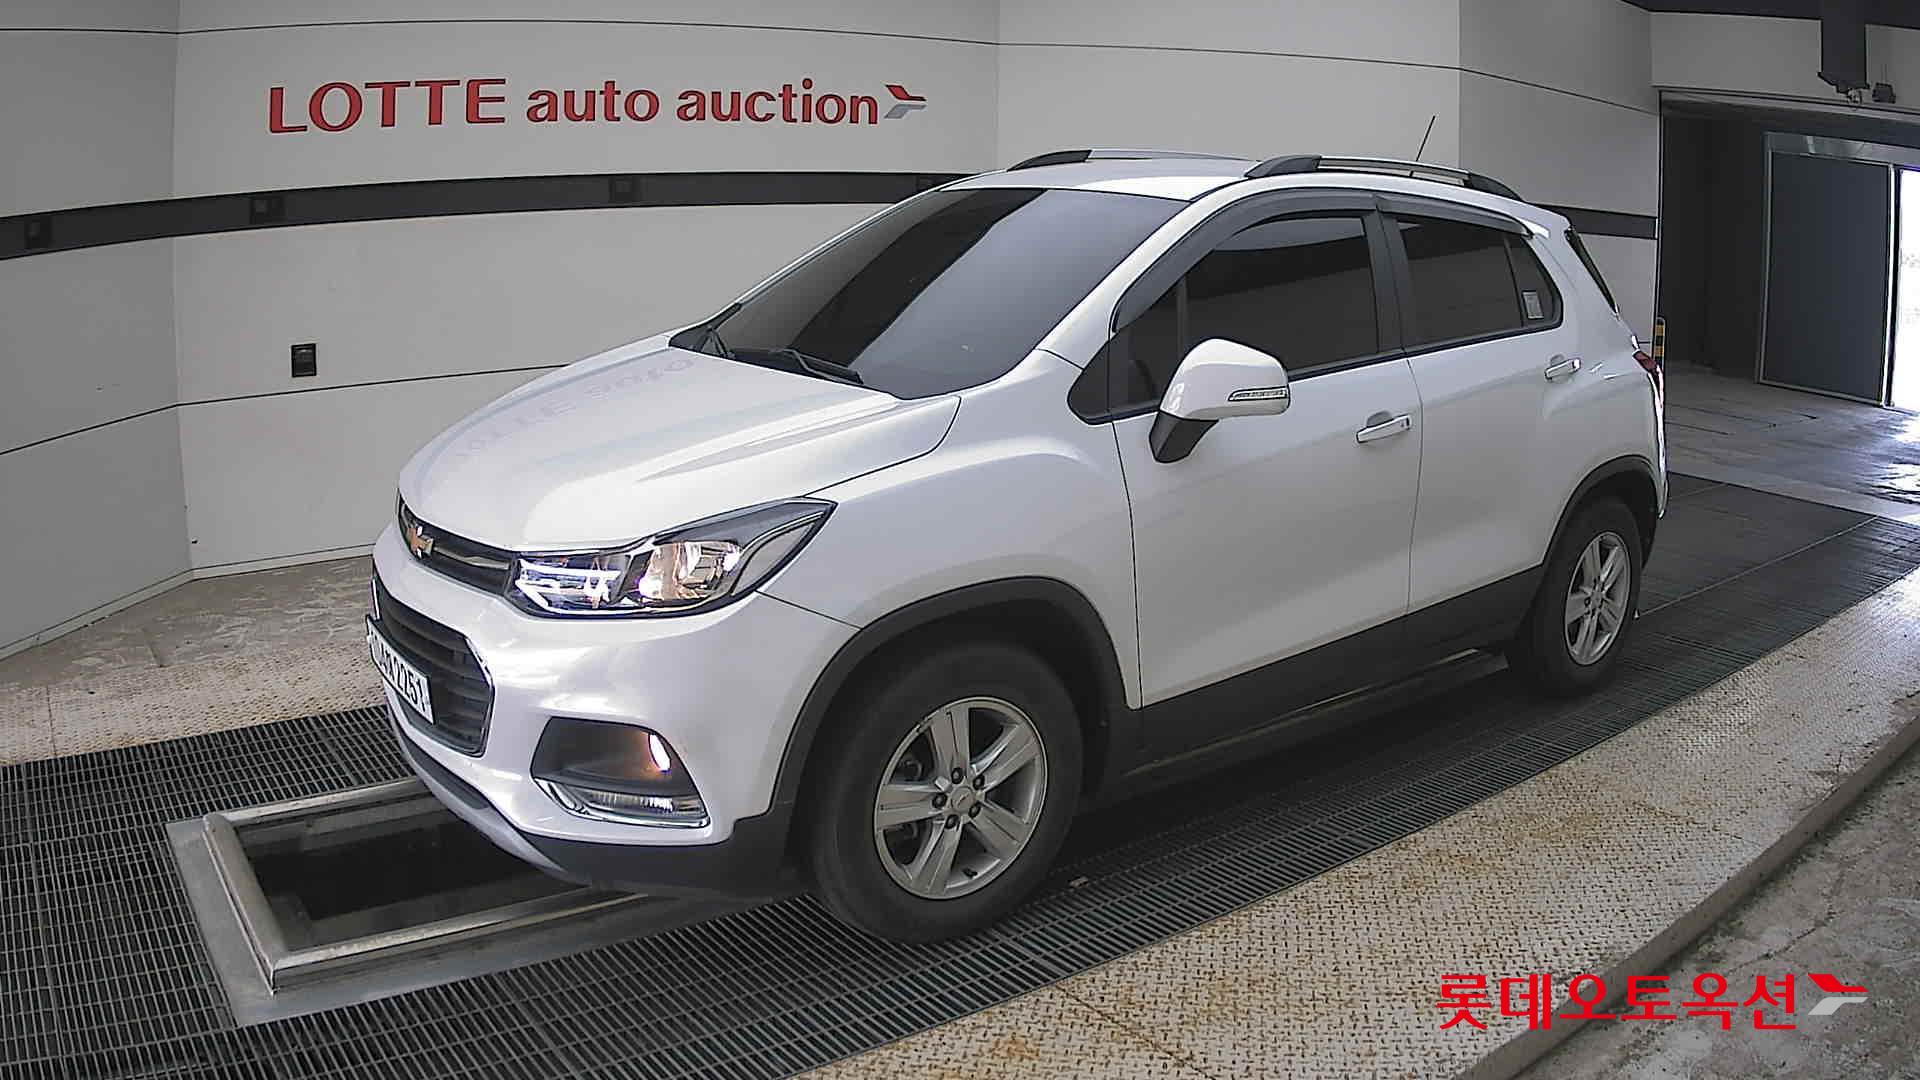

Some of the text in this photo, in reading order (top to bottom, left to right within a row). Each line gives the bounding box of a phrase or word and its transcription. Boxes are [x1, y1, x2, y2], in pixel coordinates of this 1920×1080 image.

[269, 79, 879, 133] LOTTE auto auction
